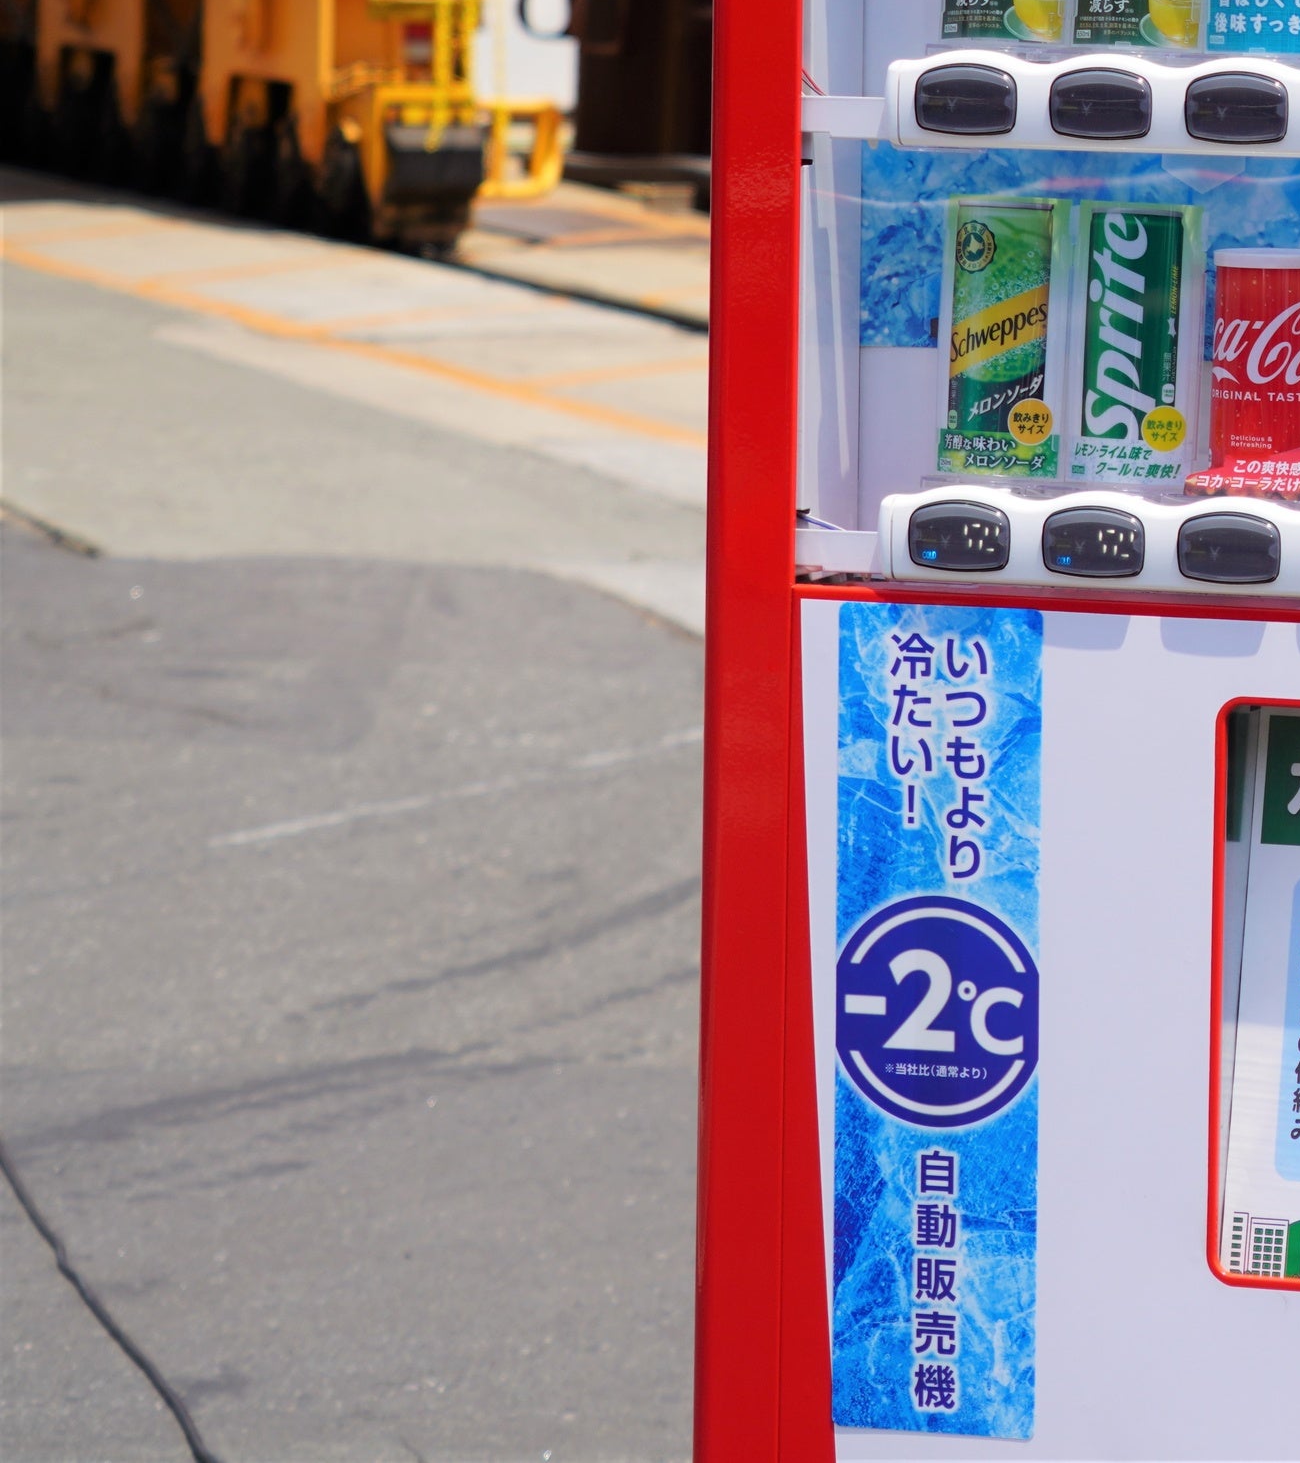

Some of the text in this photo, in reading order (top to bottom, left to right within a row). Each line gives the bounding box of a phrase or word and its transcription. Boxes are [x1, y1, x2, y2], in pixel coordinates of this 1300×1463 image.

[950, 303, 1048, 363] Schweppes
[967, 375, 1044, 421] メロンソーダ
[946, 638, 988, 879] いつもより
[914, 1151, 957, 1410] 自動販売機
